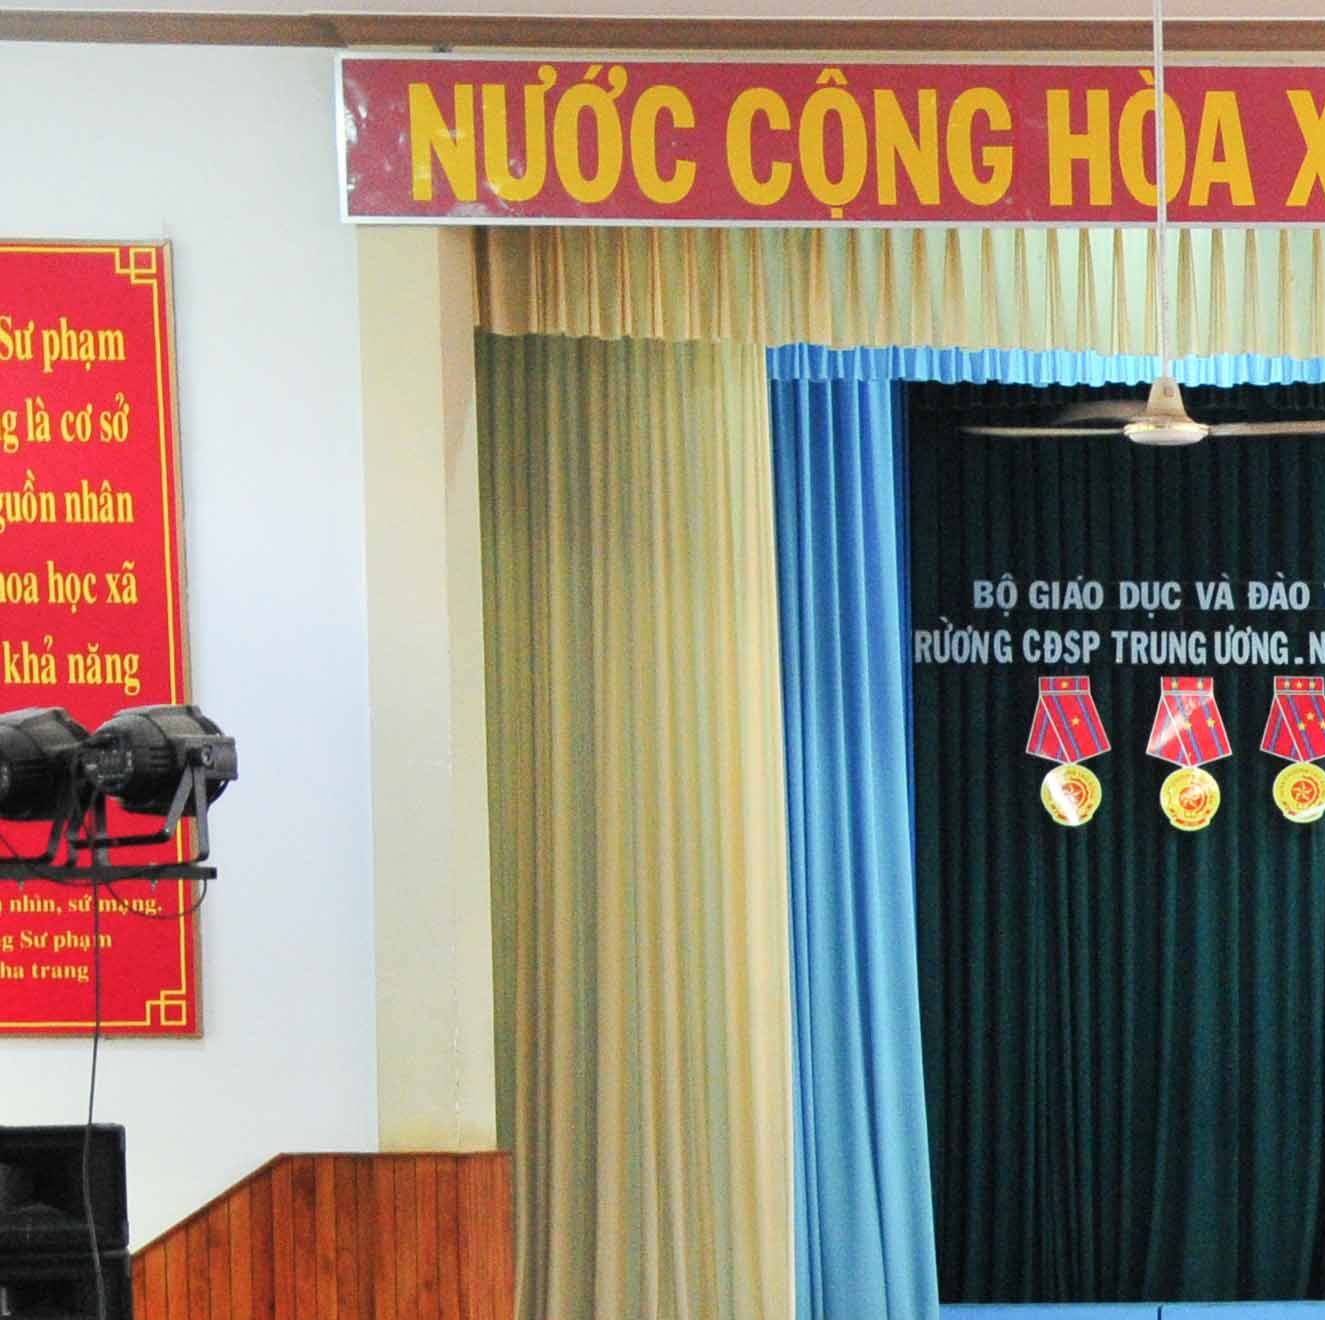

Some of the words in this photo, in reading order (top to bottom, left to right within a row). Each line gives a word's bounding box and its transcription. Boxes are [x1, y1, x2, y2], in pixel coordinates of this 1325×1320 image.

[406, 65, 701, 206] NƯỚC
[726, 68, 1014, 219] CỘNG
[1047, 68, 1250, 206] HÒA
[41, 316, 127, 374] phạm
[25, 395, 52, 443] là
[60, 402, 94, 443] cơ
[99, 391, 131, 443] sở
[64, 478, 136, 523] nhân
[46, 559, 98, 614] học
[104, 559, 139, 605] xã
[972, 572, 1019, 617] BỘ
[1028, 574, 1105, 611] GIÁO
[1119, 580, 1182, 619] DỤC
[1195, 572, 1236, 611] VÀ
[1247, 570, 1311, 611] ĐÀO
[2, 634, 58, 685] khả
[67, 641, 142, 697] năng
[913, 615, 1014, 665] RƯỜNG
[1022, 628, 1101, 665] CĐSP
[1110, 629, 1208, 666] TRUNG
[1213, 623, 1289, 666] ƯƠNG
[9, 894, 63, 917] nhìn,
[68, 894, 93, 913] sứ
[20, 930, 49, 949] Sư
[31, 961, 90, 983] trang
